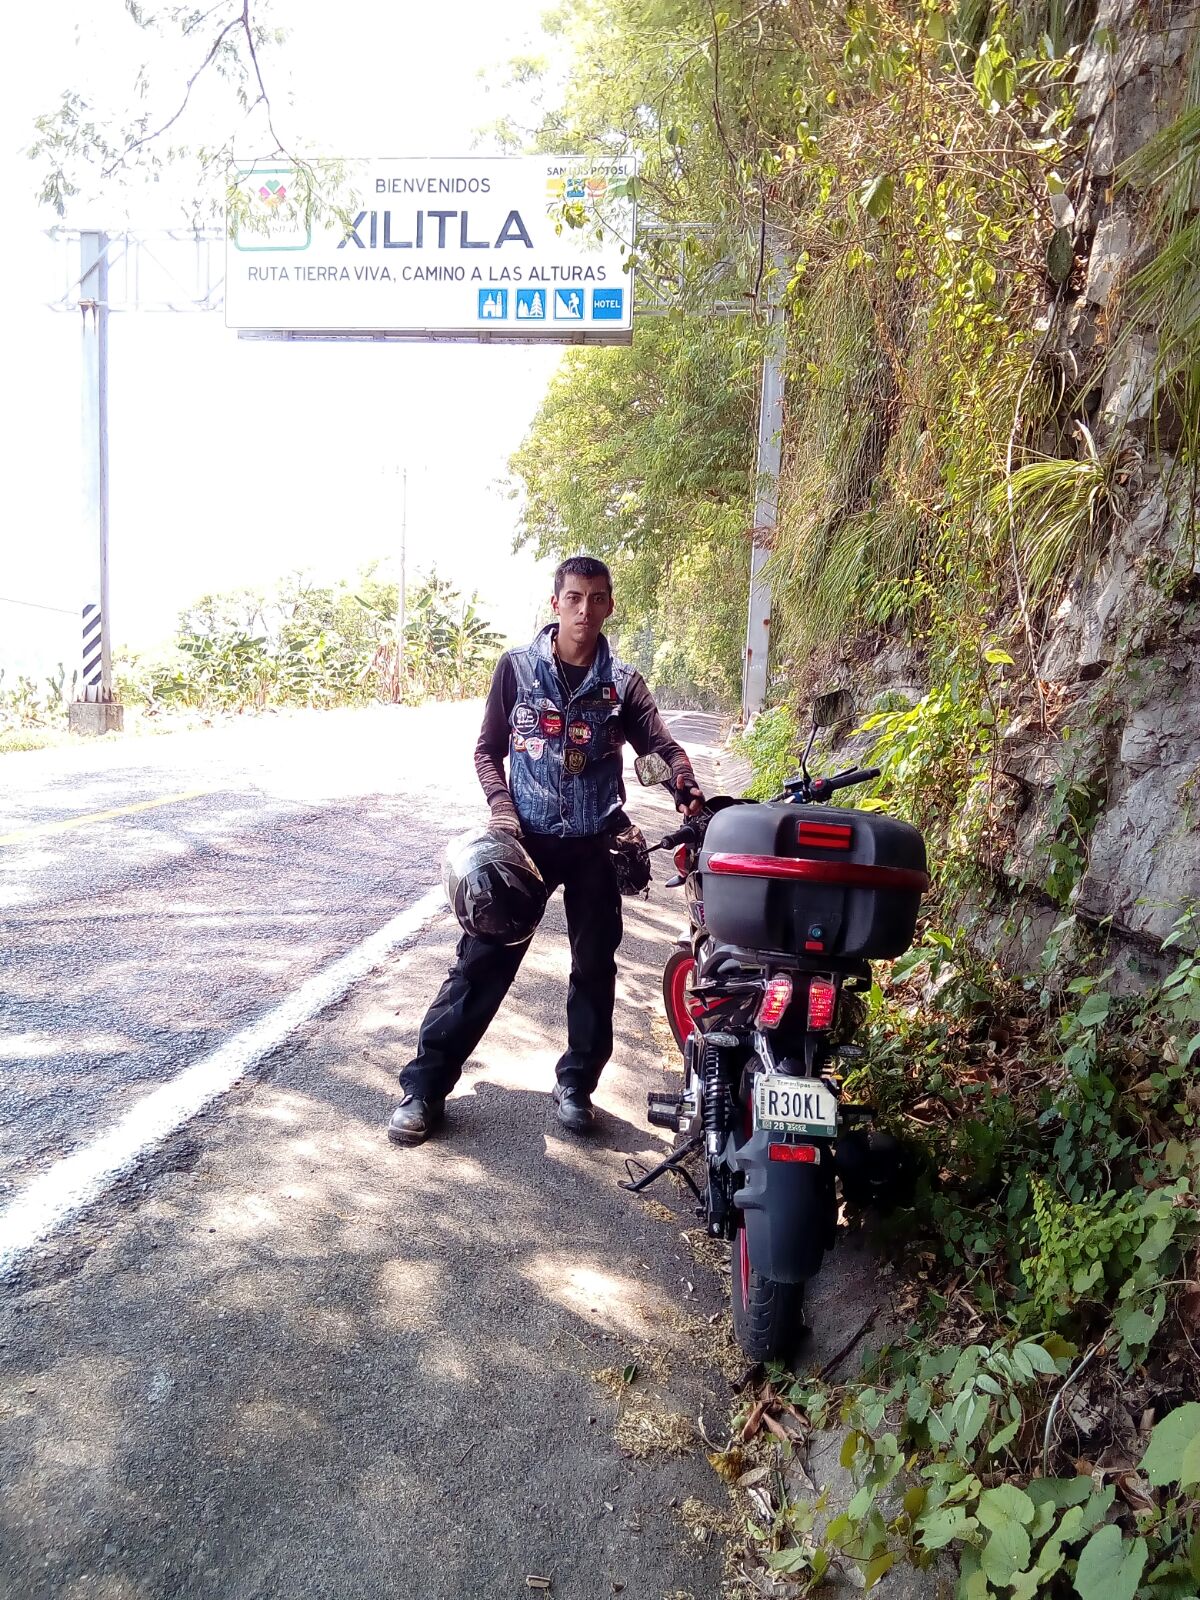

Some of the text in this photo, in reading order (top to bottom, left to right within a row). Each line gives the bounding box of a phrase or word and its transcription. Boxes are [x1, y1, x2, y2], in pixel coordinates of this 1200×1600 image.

[547, 167, 566, 176] SAN
[375, 178, 491, 193] BIENVENIDOS
[336, 210, 534, 249] XILITLA
[248, 266, 607, 283] RUTA TIERRA VIVA, CAMINO A LAS ALTURAS
[593, 300, 621, 309] HOTEL
[769, 1090, 825, 1120] R30KL
[773, 1122, 785, 1131] 28
